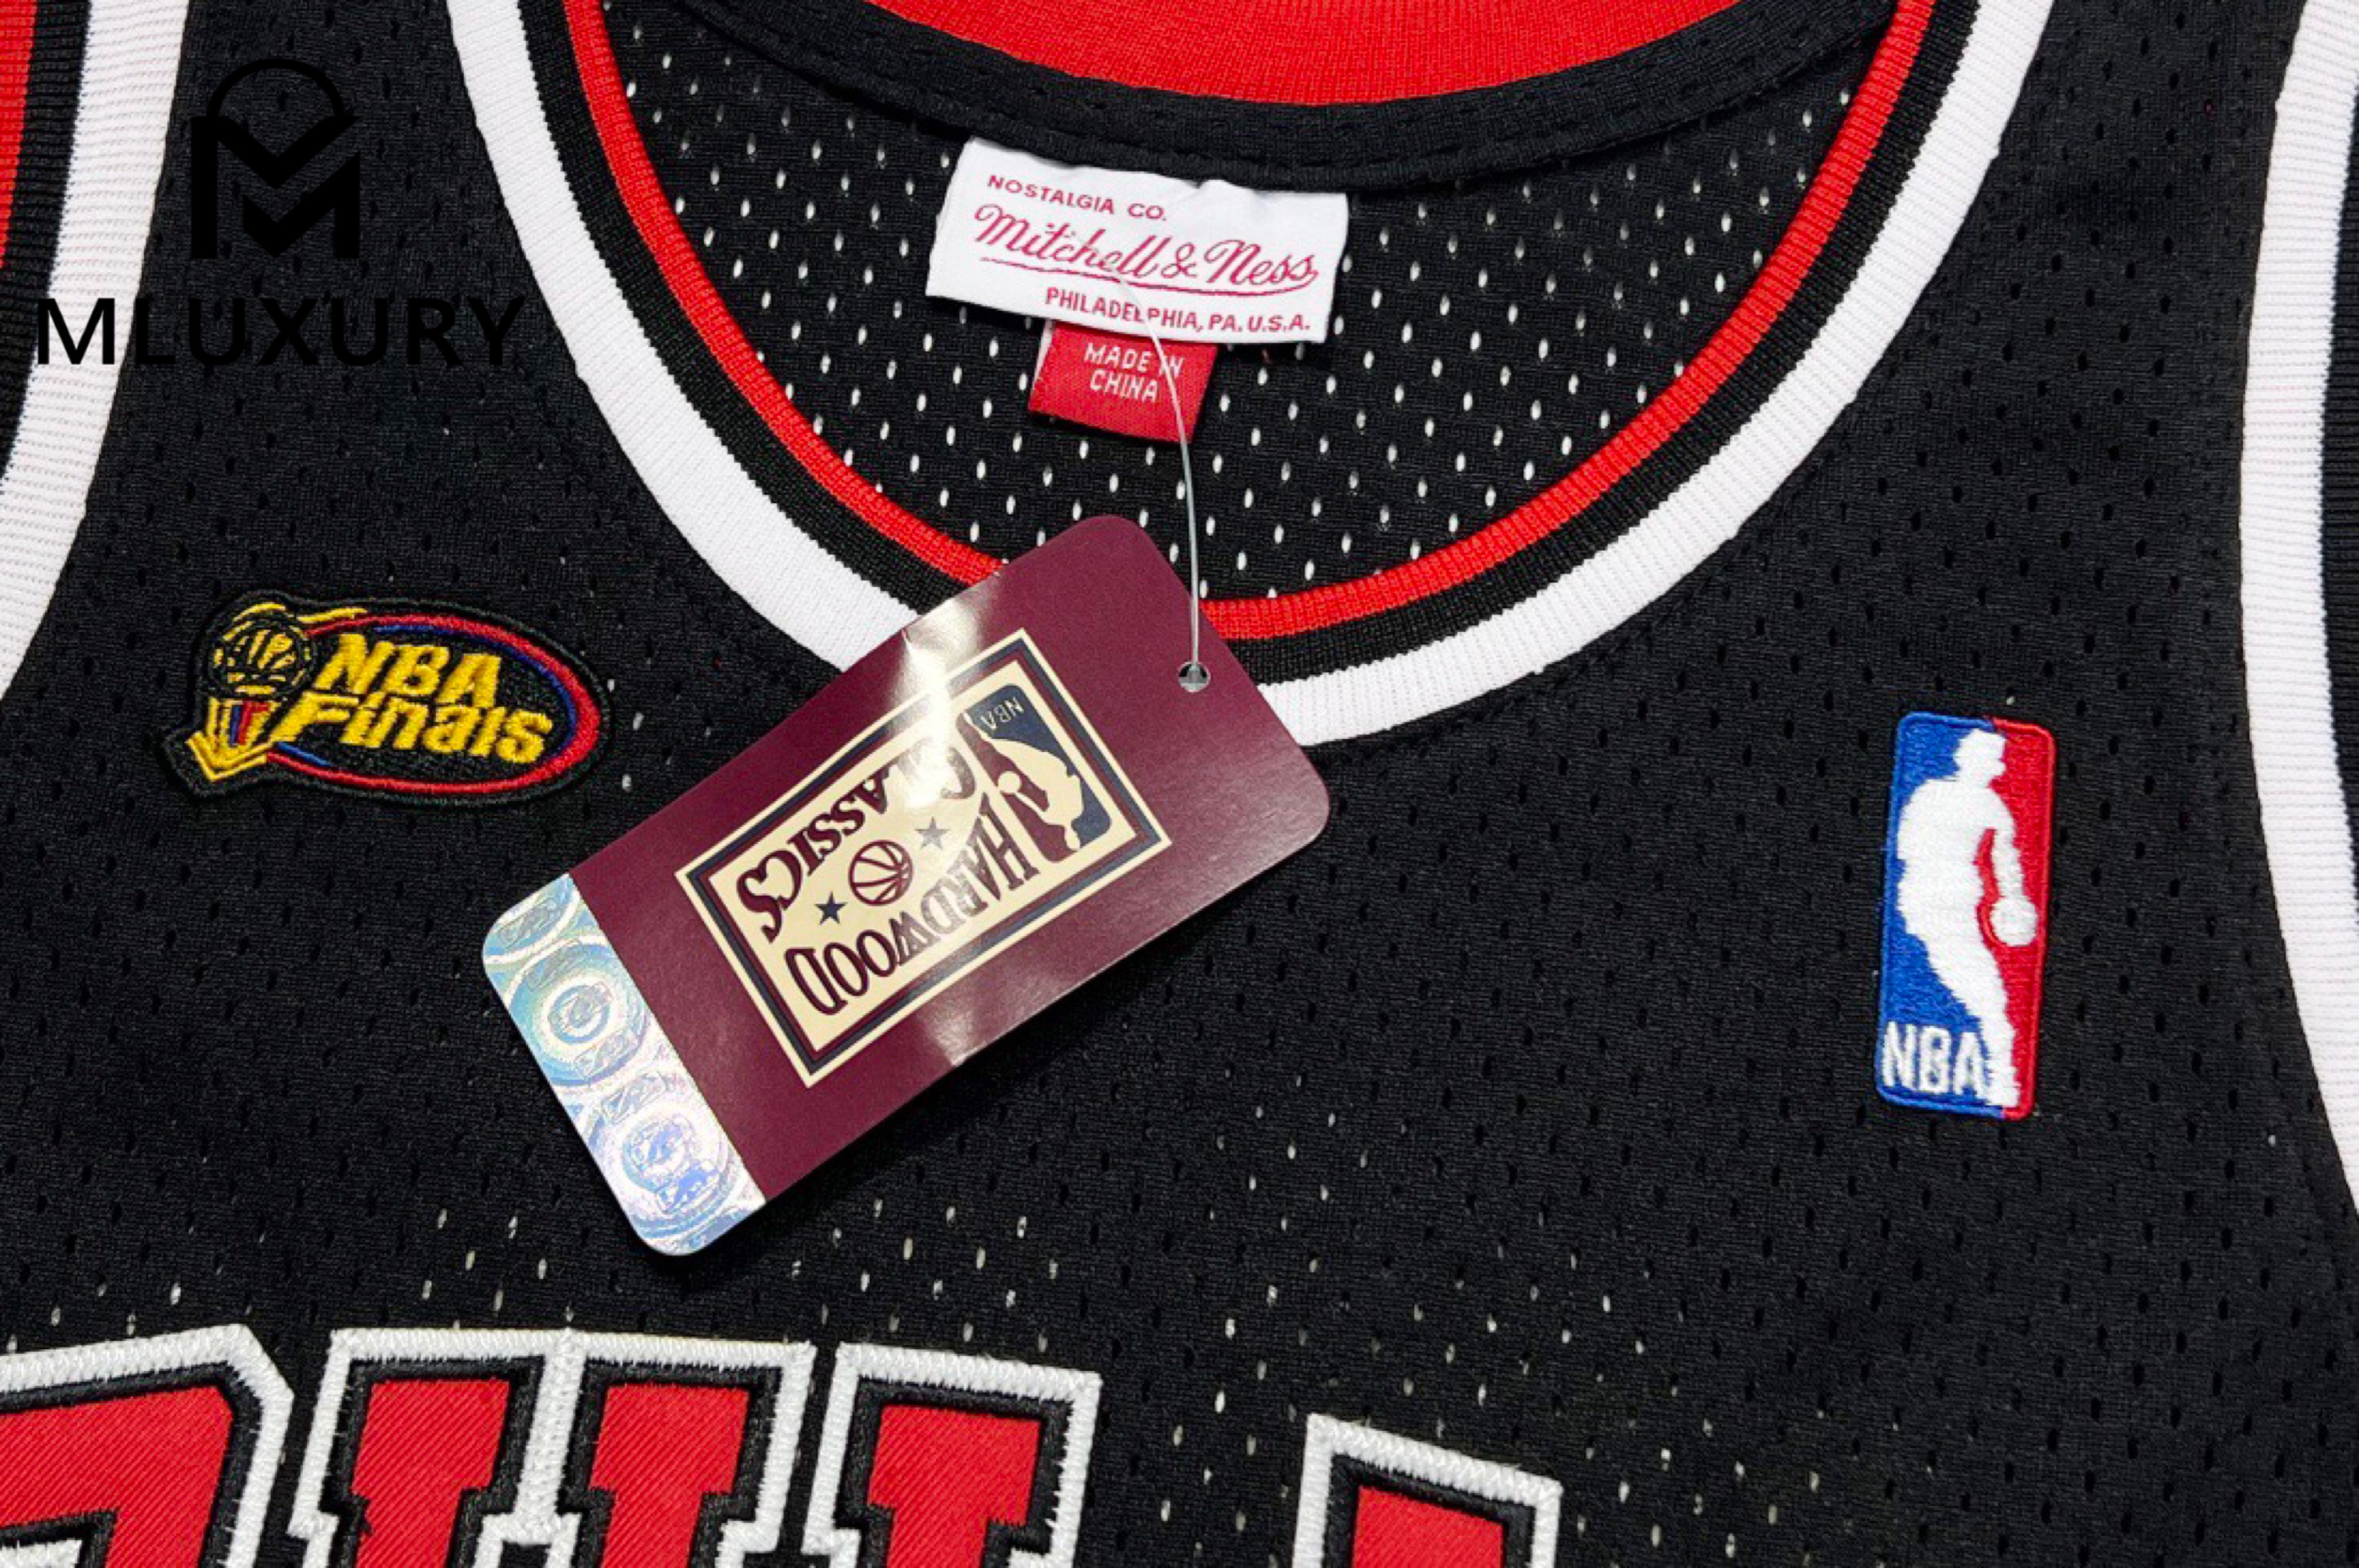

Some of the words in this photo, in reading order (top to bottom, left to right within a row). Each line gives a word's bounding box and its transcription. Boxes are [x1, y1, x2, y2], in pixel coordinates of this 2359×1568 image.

[988, 175, 1114, 215] NOSTALGIA
[1127, 203, 1166, 221] CO.
[974, 203, 1173, 278] Mitchell
[1161, 242, 1197, 279] &
[1203, 239, 1318, 285] Ness
[1046, 287, 1203, 332] PHILADELPHIA,
[1208, 314, 1242, 332] PA.
[1246, 314, 1311, 332] U.S.A.
[1084, 342, 1153, 373] MADE
[1090, 368, 1158, 403] CHINA
[314, 633, 502, 708] NBA
[270, 691, 554, 764] Finals
[980, 696, 1025, 731] NBA
[784, 791, 1041, 1016] HARDWOOD
[1882, 1021, 1987, 1100] NBA
